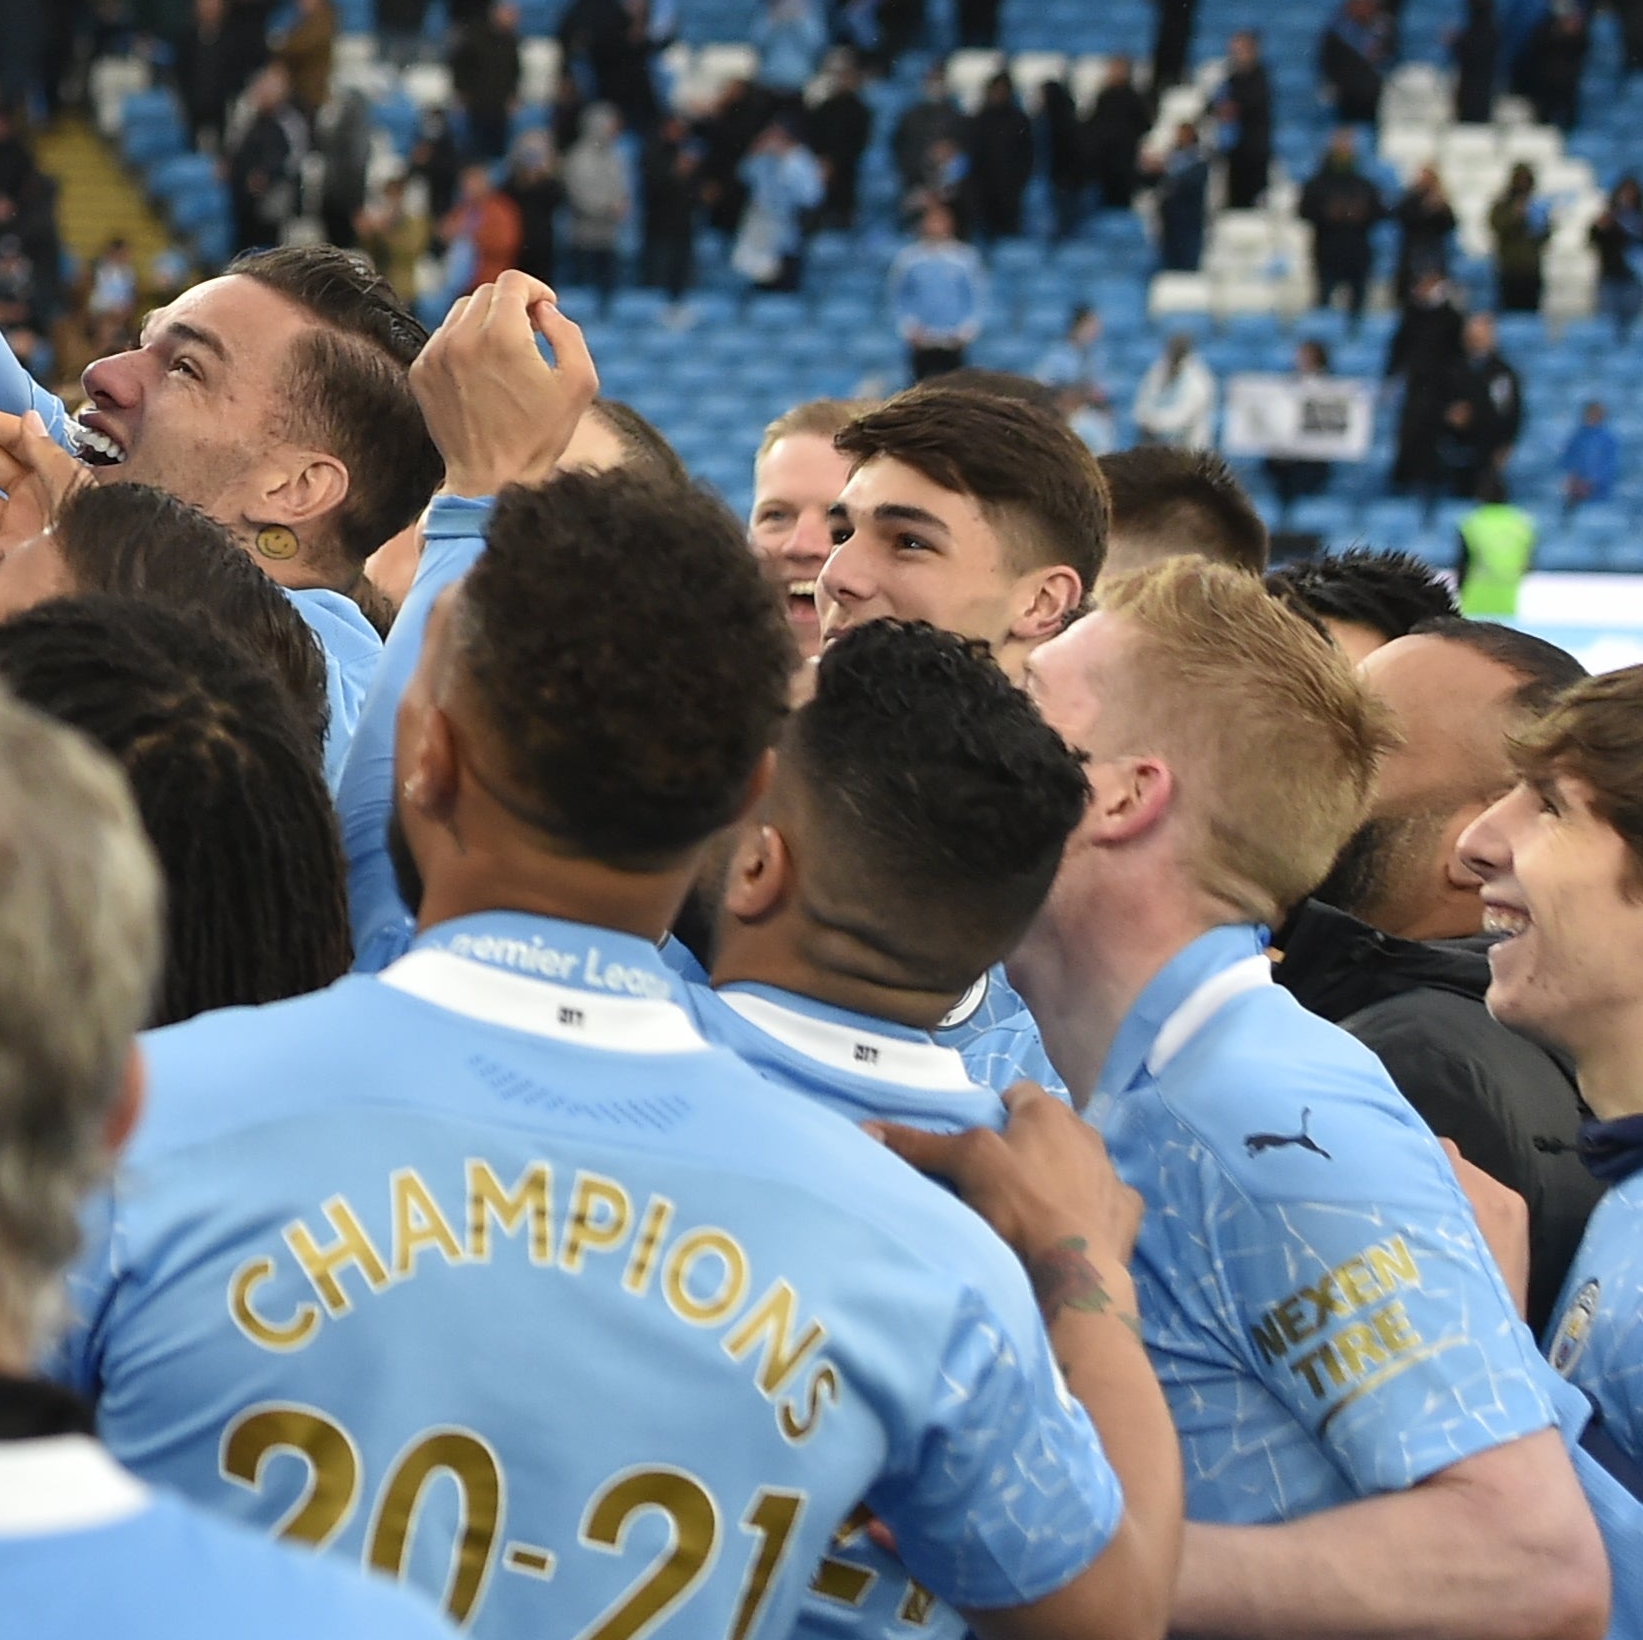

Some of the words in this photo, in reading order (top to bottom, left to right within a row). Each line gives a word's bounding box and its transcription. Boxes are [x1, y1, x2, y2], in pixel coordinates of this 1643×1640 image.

[447, 932, 581, 982] remier
[227, 1157, 841, 1447] CHAMPIONS
[1251, 1232, 1422, 1366] NEXEN
[1289, 1298, 1423, 1399] TIRE
[218, 1399, 808, 1640] 20-21
